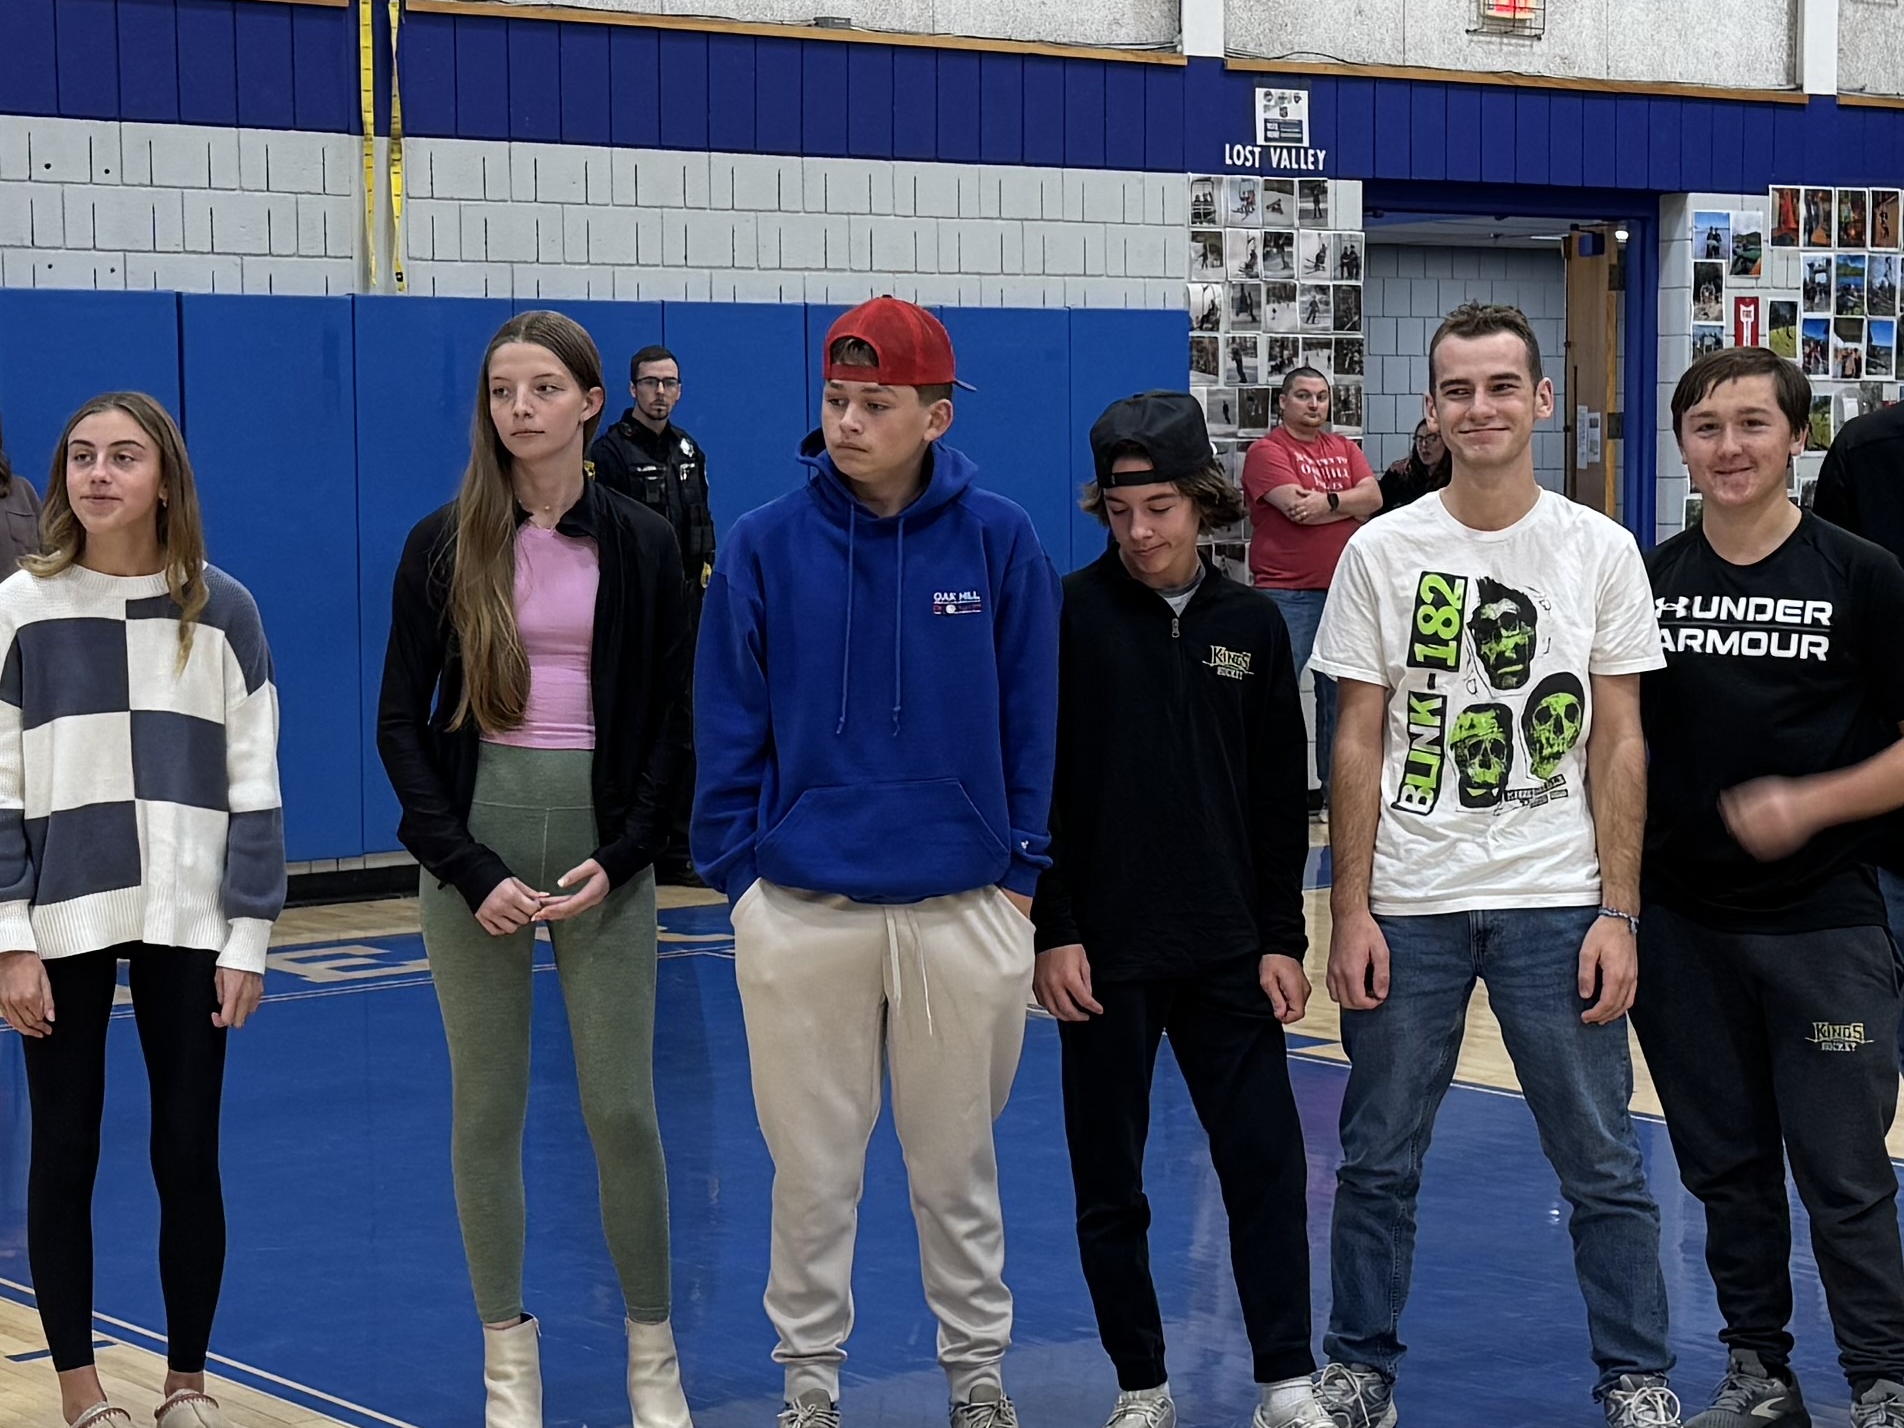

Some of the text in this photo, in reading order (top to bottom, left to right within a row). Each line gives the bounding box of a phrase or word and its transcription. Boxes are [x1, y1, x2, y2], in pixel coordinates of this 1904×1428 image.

[1225, 143, 1326, 171] LOST VALLEY
[933, 592, 956, 601] OAK
[1692, 596, 1834, 626] UNDER
[1660, 628, 1830, 661] ARMOUR
